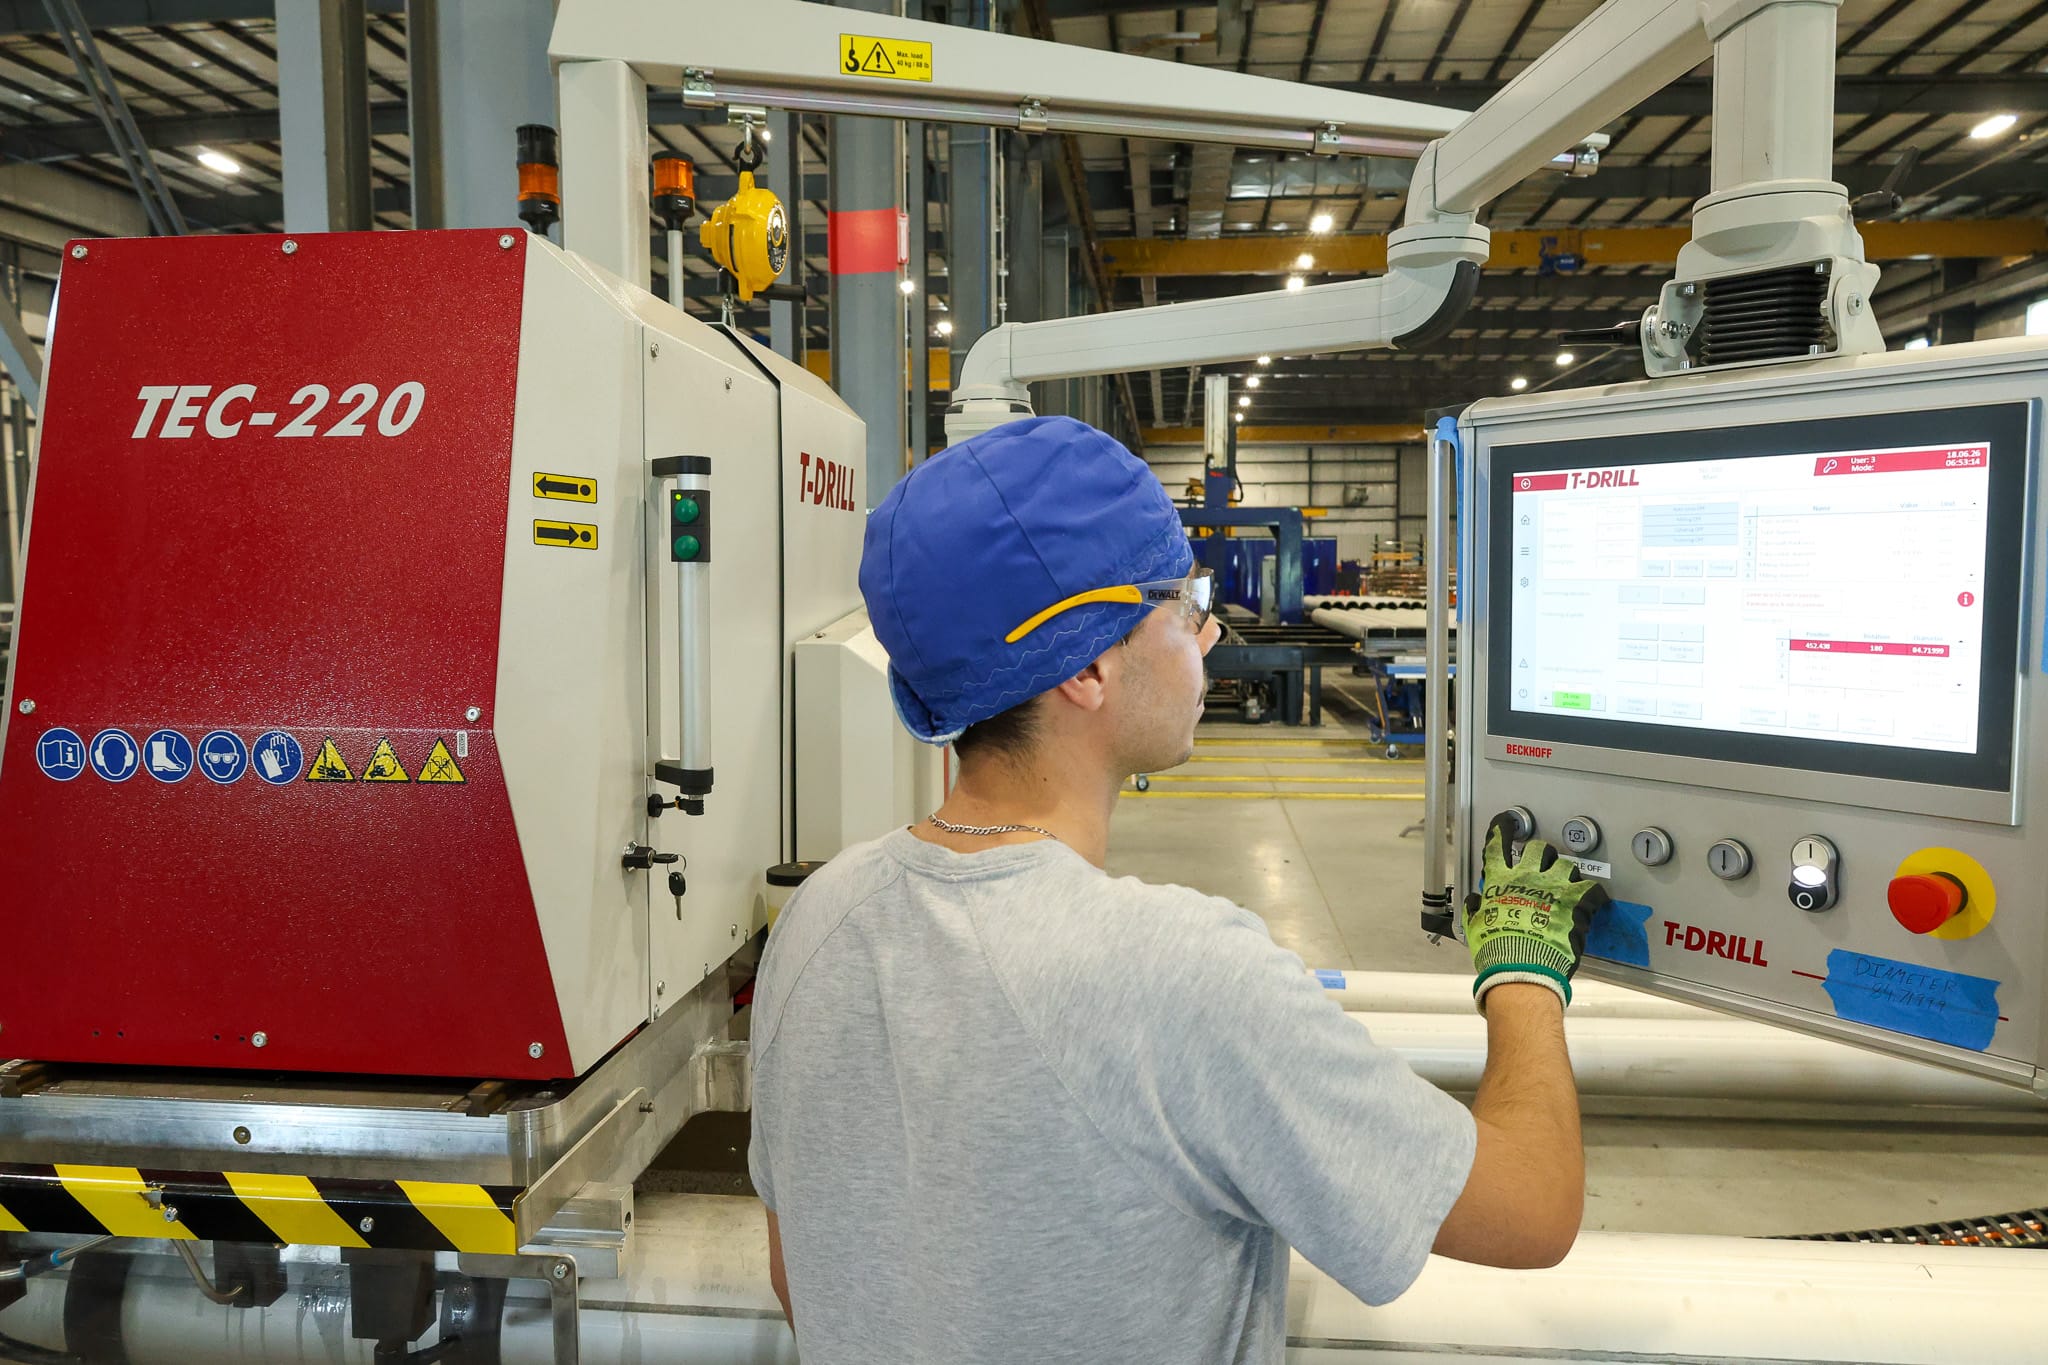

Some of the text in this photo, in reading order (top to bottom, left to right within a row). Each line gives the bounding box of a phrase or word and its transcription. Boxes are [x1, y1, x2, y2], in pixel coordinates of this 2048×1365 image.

[131, 381, 426, 439] TEC-220
[800, 451, 855, 512] T-DRILL
[1571, 468, 1640, 490] T-DRILL
[1851, 464, 1875, 472] Mode:
[1506, 743, 1553, 759] BECKHOFF
[1587, 863, 1603, 873] OFF
[1663, 920, 1768, 968] T-DRILL
[1855, 957, 1958, 993] DIAMETER
